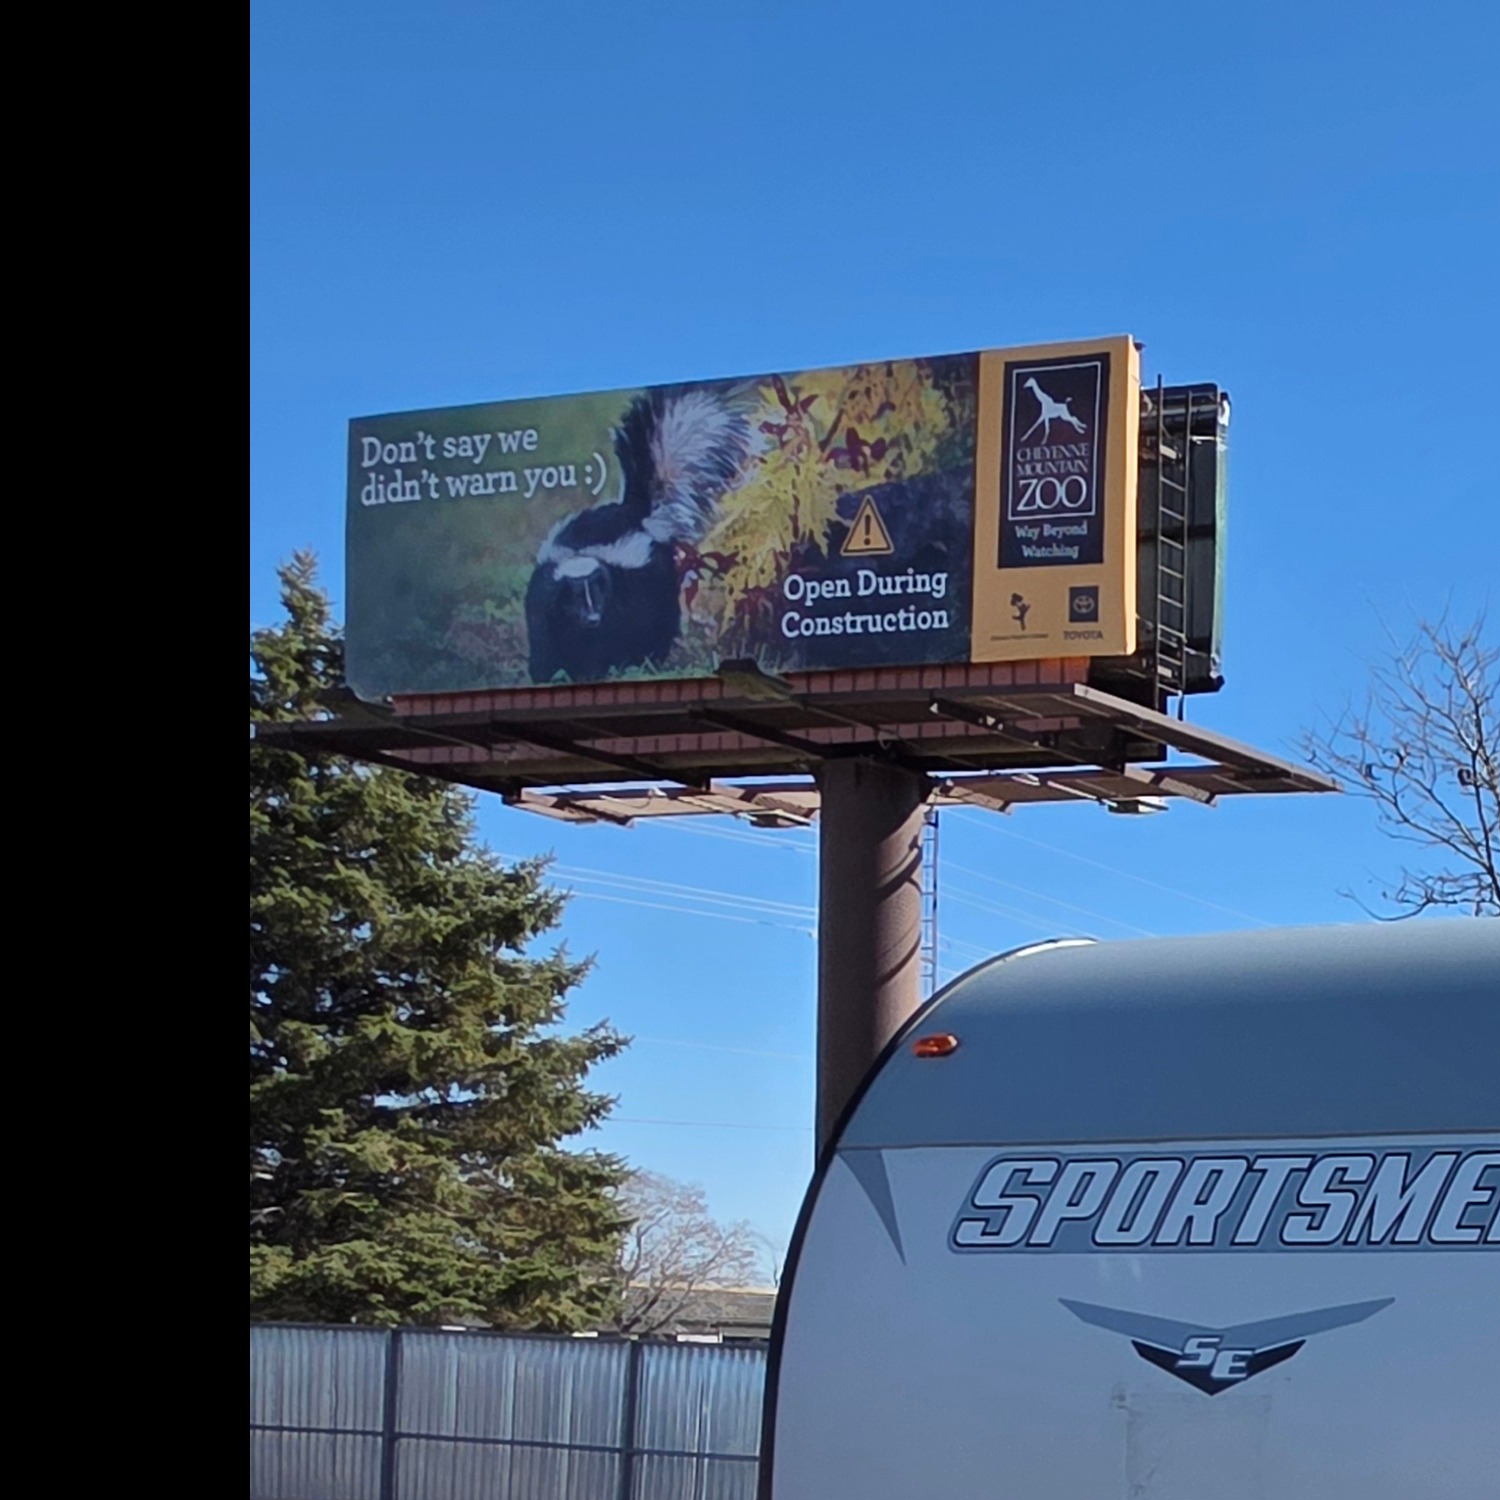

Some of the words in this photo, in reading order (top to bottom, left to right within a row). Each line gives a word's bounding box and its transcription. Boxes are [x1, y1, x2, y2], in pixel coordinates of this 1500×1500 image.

[361, 431, 437, 467] Don't
[443, 433, 491, 464] say
[498, 429, 538, 453] we
[1016, 443, 1090, 462] CHEYENNE
[361, 469, 440, 506] didn't
[445, 470, 518, 497] warn
[524, 465, 577, 498] you
[1017, 460, 1089, 477] MOUNTAIN
[1016, 475, 1088, 511] ZOO
[1015, 525, 1040, 540] Way
[1043, 520, 1088, 540] Beyond
[1022, 544, 1079, 559] Watching
[784, 574, 851, 606] Open
[857, 567, 948, 598] During
[782, 604, 949, 638] Construction
[1063, 630, 1104, 640] TOYOTA
[1177, 1335, 1258, 1381] SE
